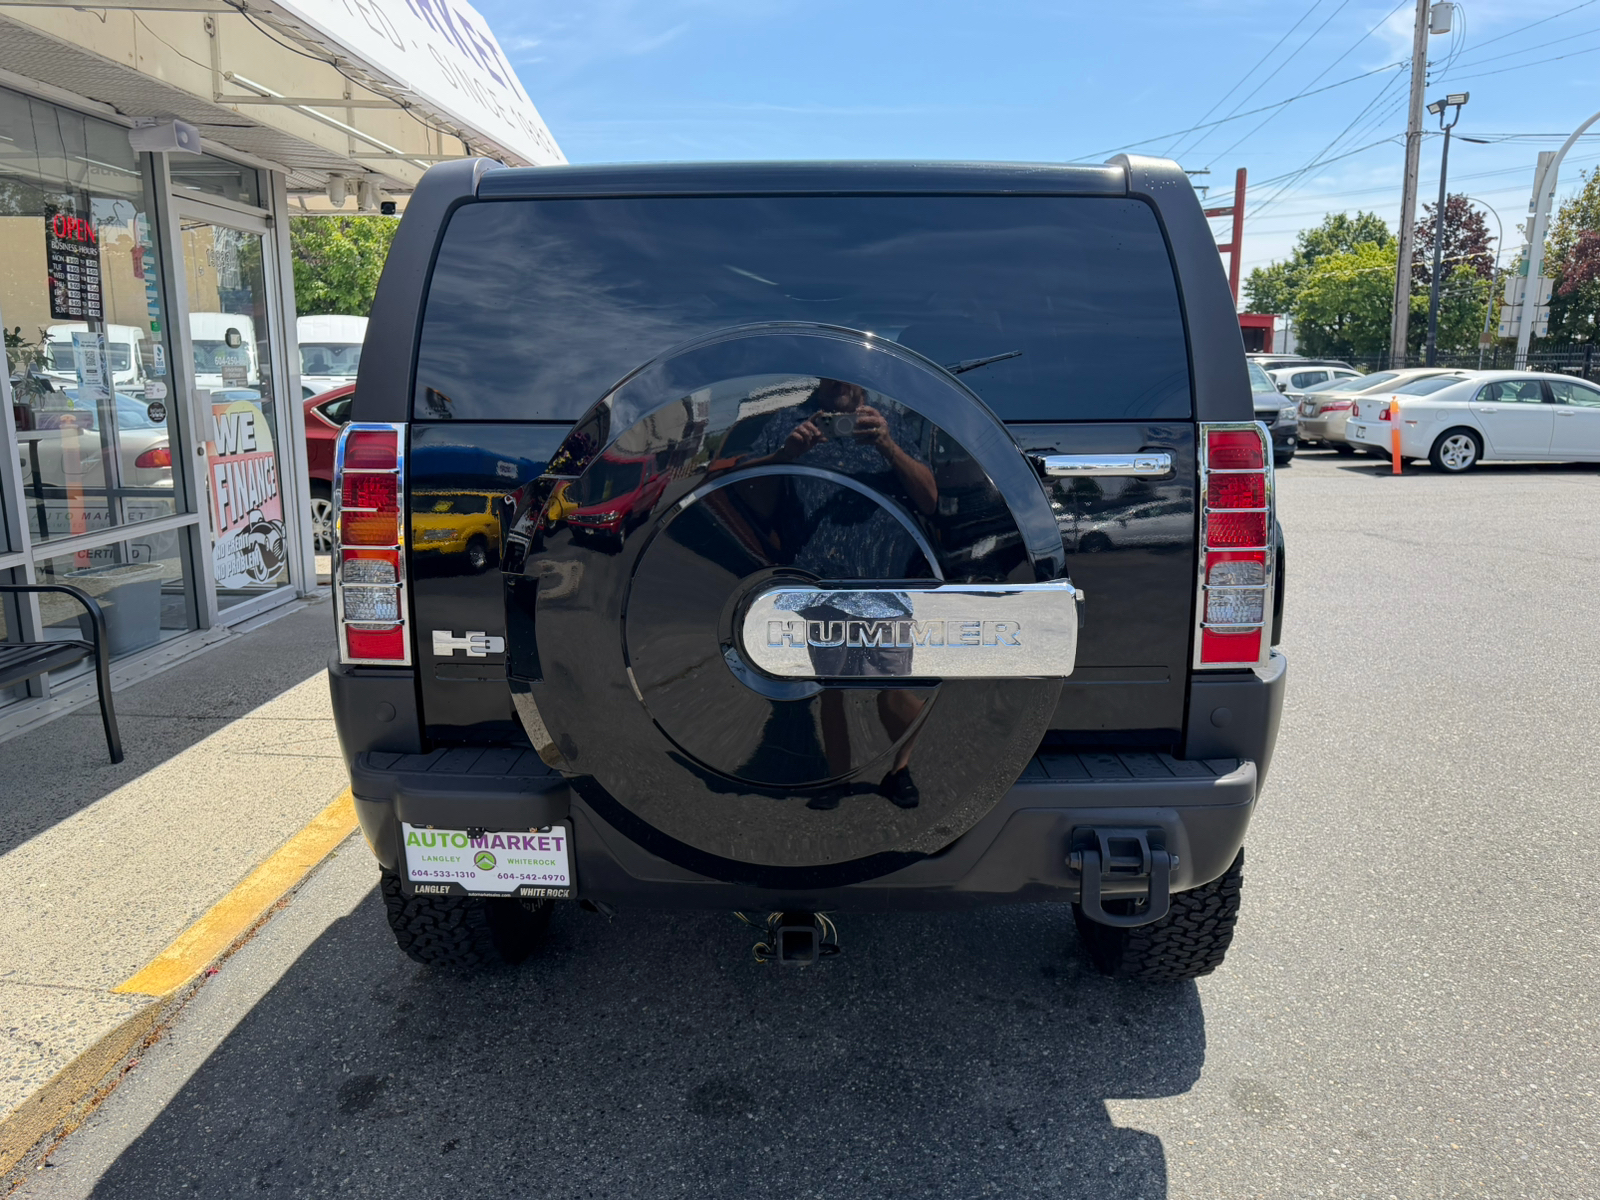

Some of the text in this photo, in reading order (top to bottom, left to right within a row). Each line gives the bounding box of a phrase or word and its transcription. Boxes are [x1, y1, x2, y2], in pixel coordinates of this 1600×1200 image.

[427, 43, 516, 129] SINCE
[53, 214, 97, 244] OPEN
[51, 240, 98, 256] BUSINESS HOURS
[213, 411, 257, 457] WE
[213, 455, 277, 532] FINANCE
[82, 511, 145, 520] MARET
[77, 549, 139, 559] CERTID
[217, 543, 226, 561] NO
[216, 562, 226, 581] NO
[767, 620, 1021, 647] HUMMER
[432, 630, 505, 657] H3
[406, 831, 564, 851] AUTOMARKET
[421, 855, 556, 866] LANGLEY WHITEROCK
[411, 869, 566, 882] 604-533-1310 604-542-4970
[415, 885, 570, 898] LANGLEY WHITE ROCK
